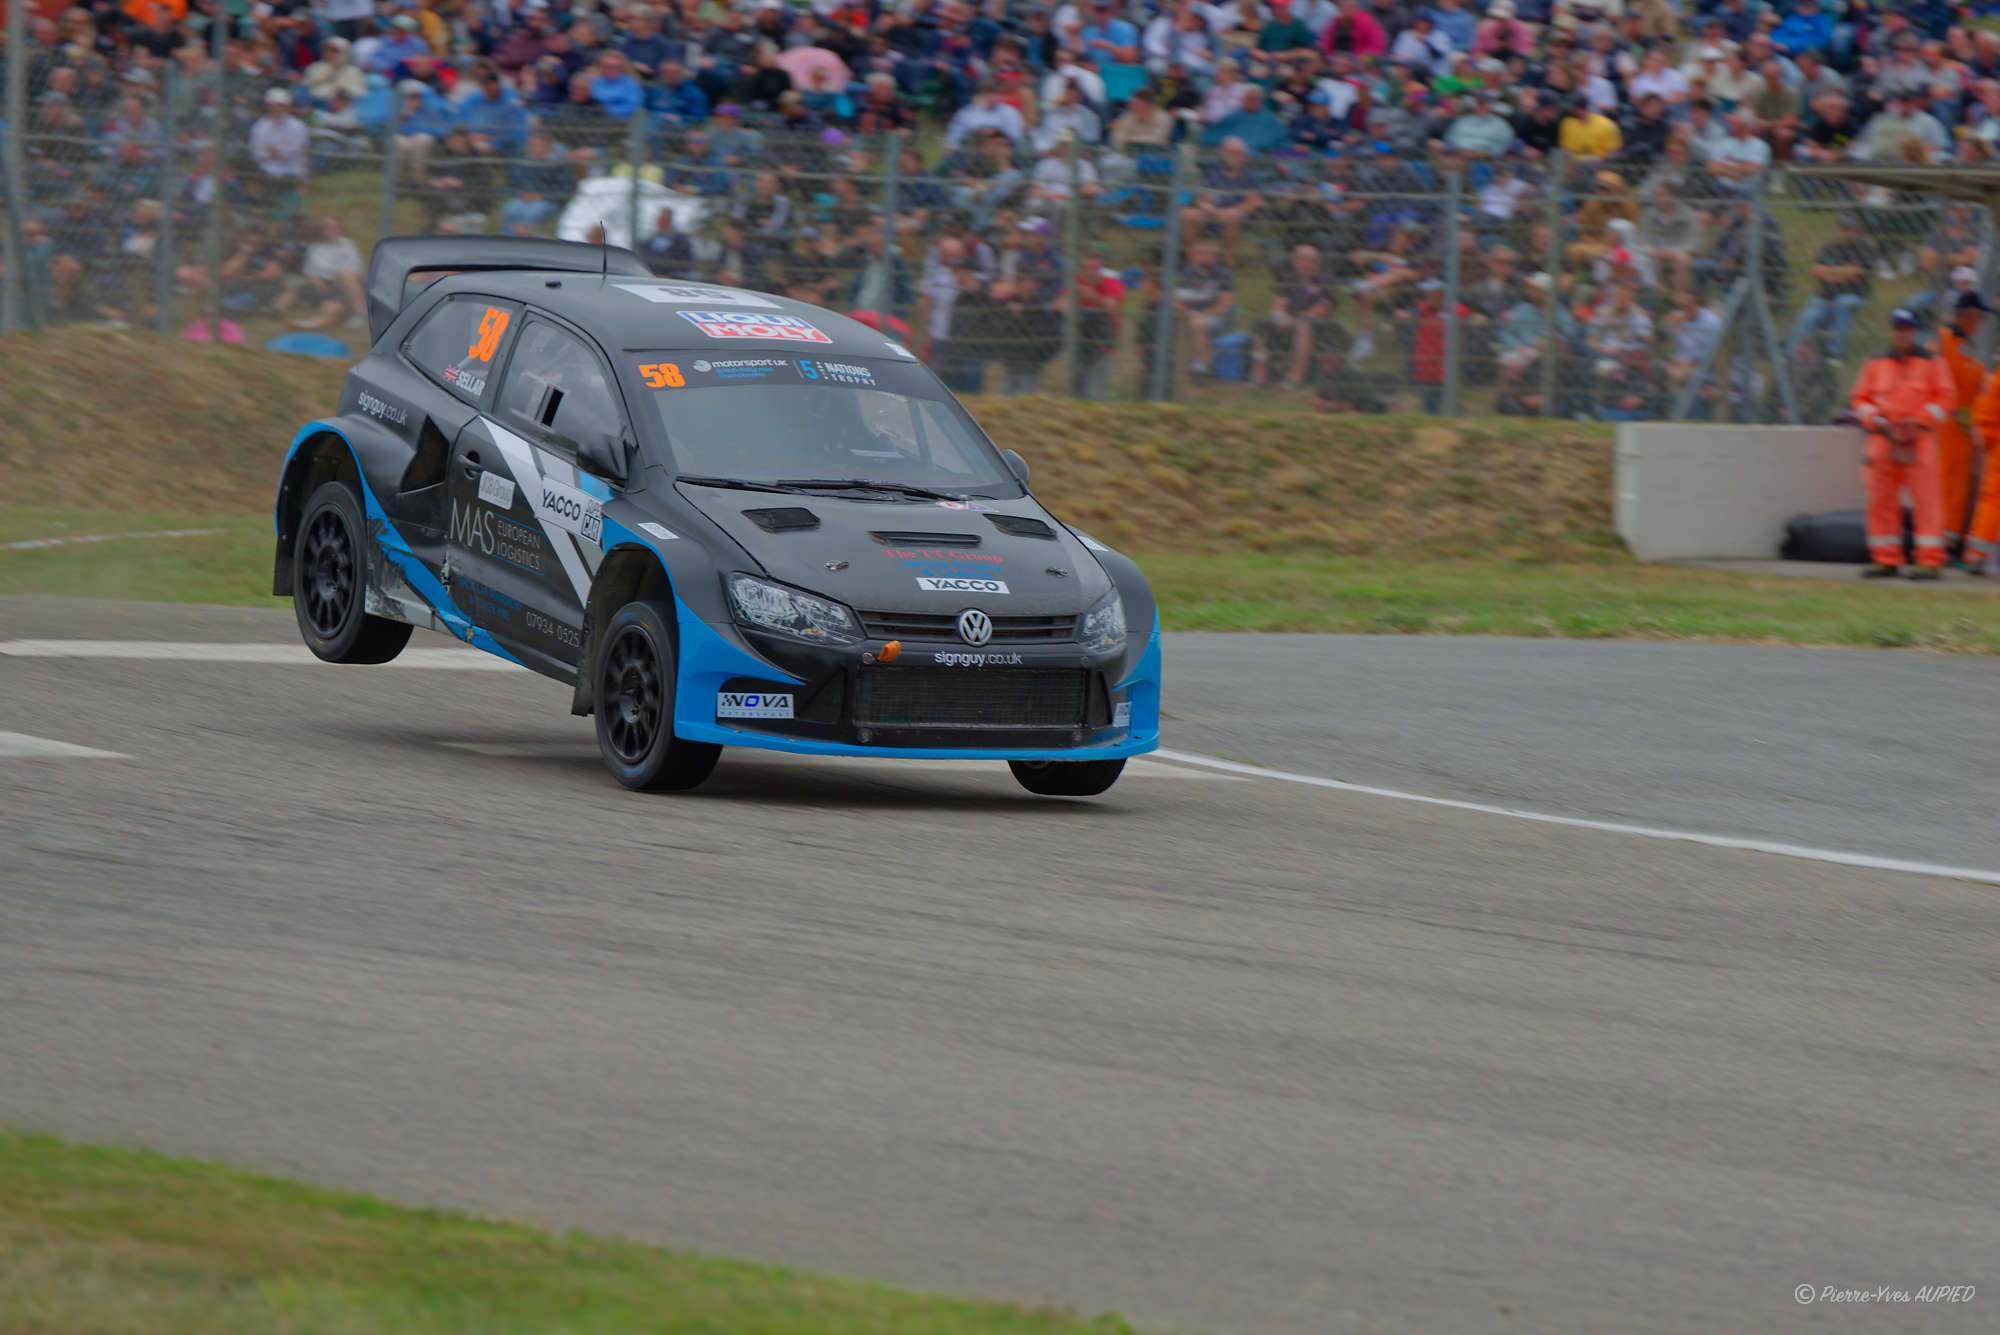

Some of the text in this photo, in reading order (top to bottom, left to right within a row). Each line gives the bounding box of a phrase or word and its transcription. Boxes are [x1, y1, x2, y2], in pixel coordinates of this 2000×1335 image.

[691, 311, 809, 328] LIQUI
[468, 307, 509, 362] 58
[703, 323, 819, 341] MOLY
[712, 359, 772, 368] motorsport
[800, 359, 819, 380] 5
[824, 361, 872, 377] NATIONS
[638, 363, 686, 388] 58
[830, 373, 876, 386] TROPHY
[358, 390, 408, 426] signguy.co.uk
[542, 488, 581, 520] YACCO
[450, 497, 495, 555] MAS
[497, 520, 541, 549] EUROPEAN
[496, 541, 541, 570] LOGISTICS
[882, 549, 917, 559] The
[918, 549, 944, 559] TT
[926, 579, 999, 591] YACCO
[934, 650, 1023, 667] signguy.co.uk
[730, 695, 789, 708] NOVA
